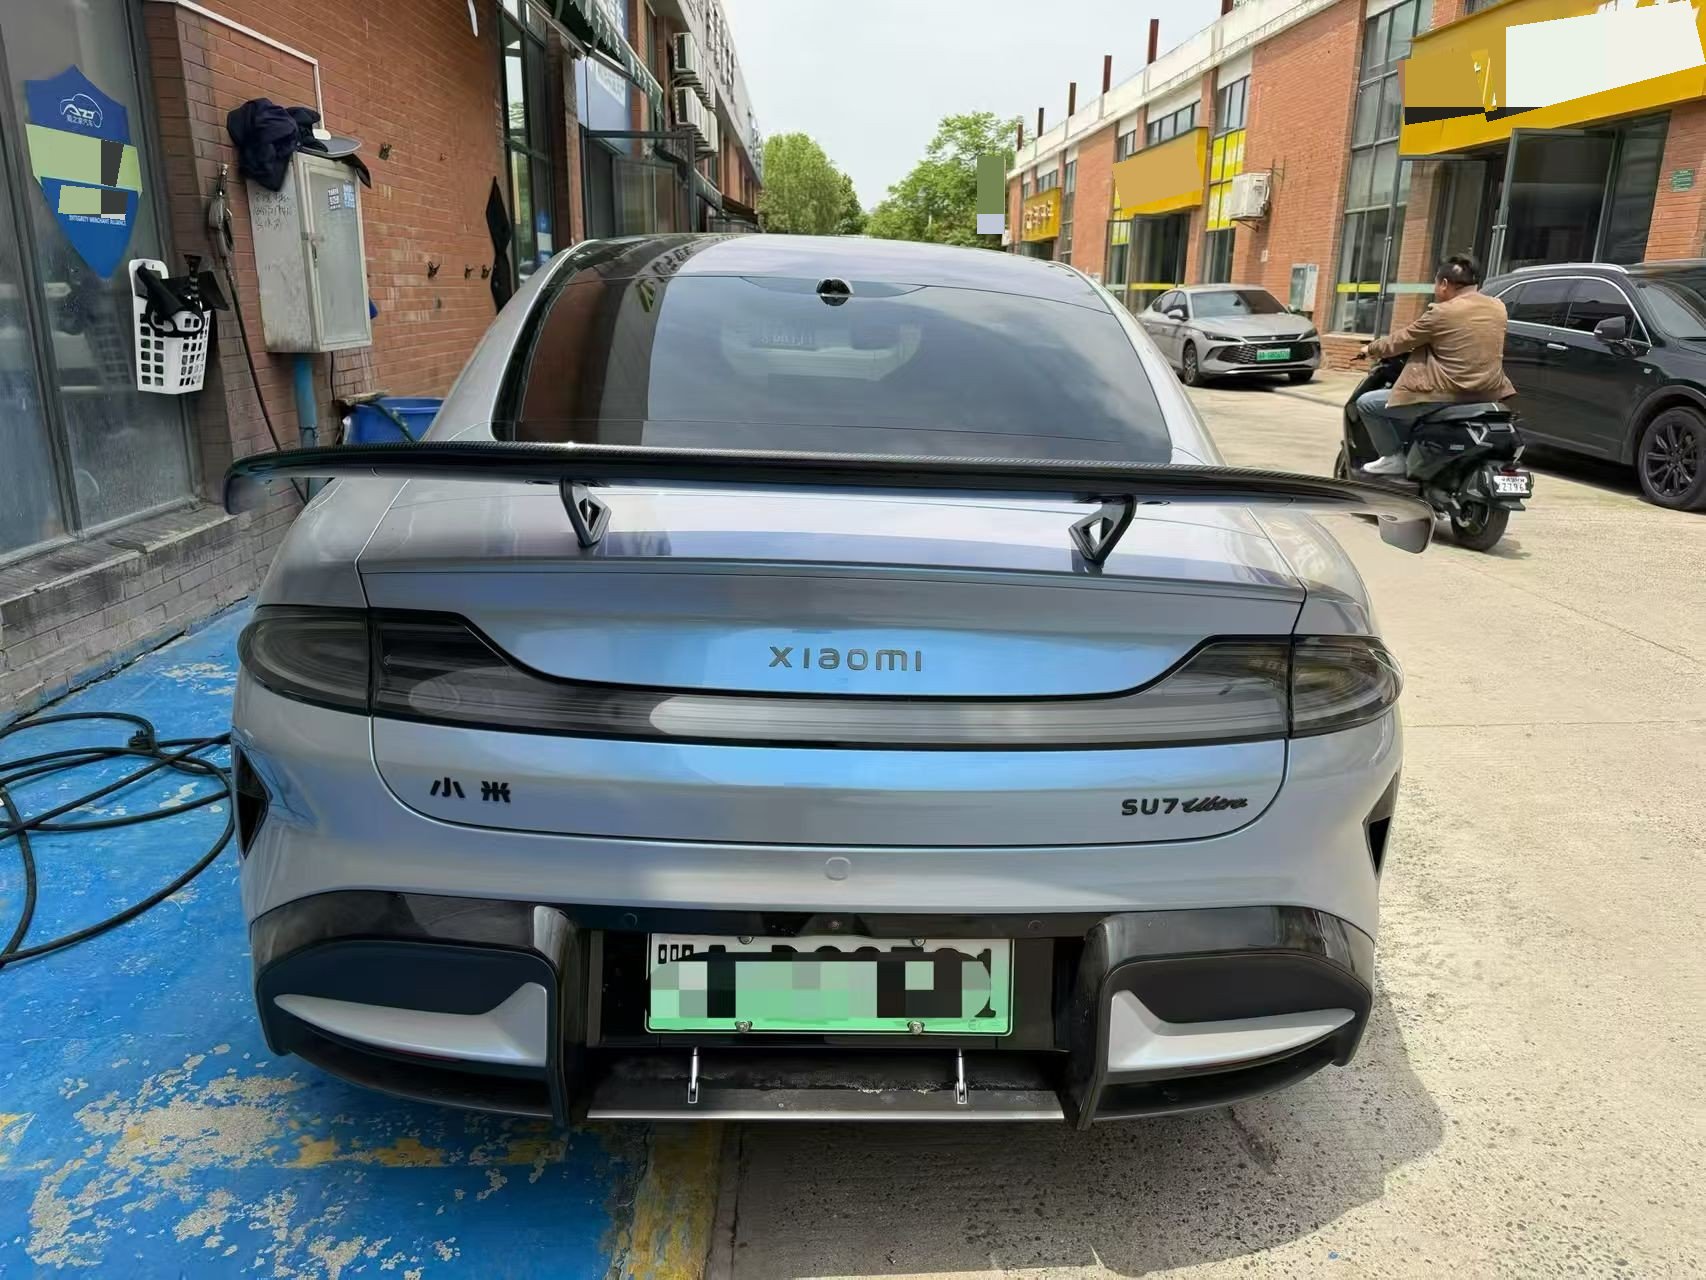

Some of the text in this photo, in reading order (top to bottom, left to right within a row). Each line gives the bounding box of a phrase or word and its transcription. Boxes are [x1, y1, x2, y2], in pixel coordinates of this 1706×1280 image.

[429, 777, 511, 803] 小米
[1121, 795, 1248, 816] SU7 Ultra
